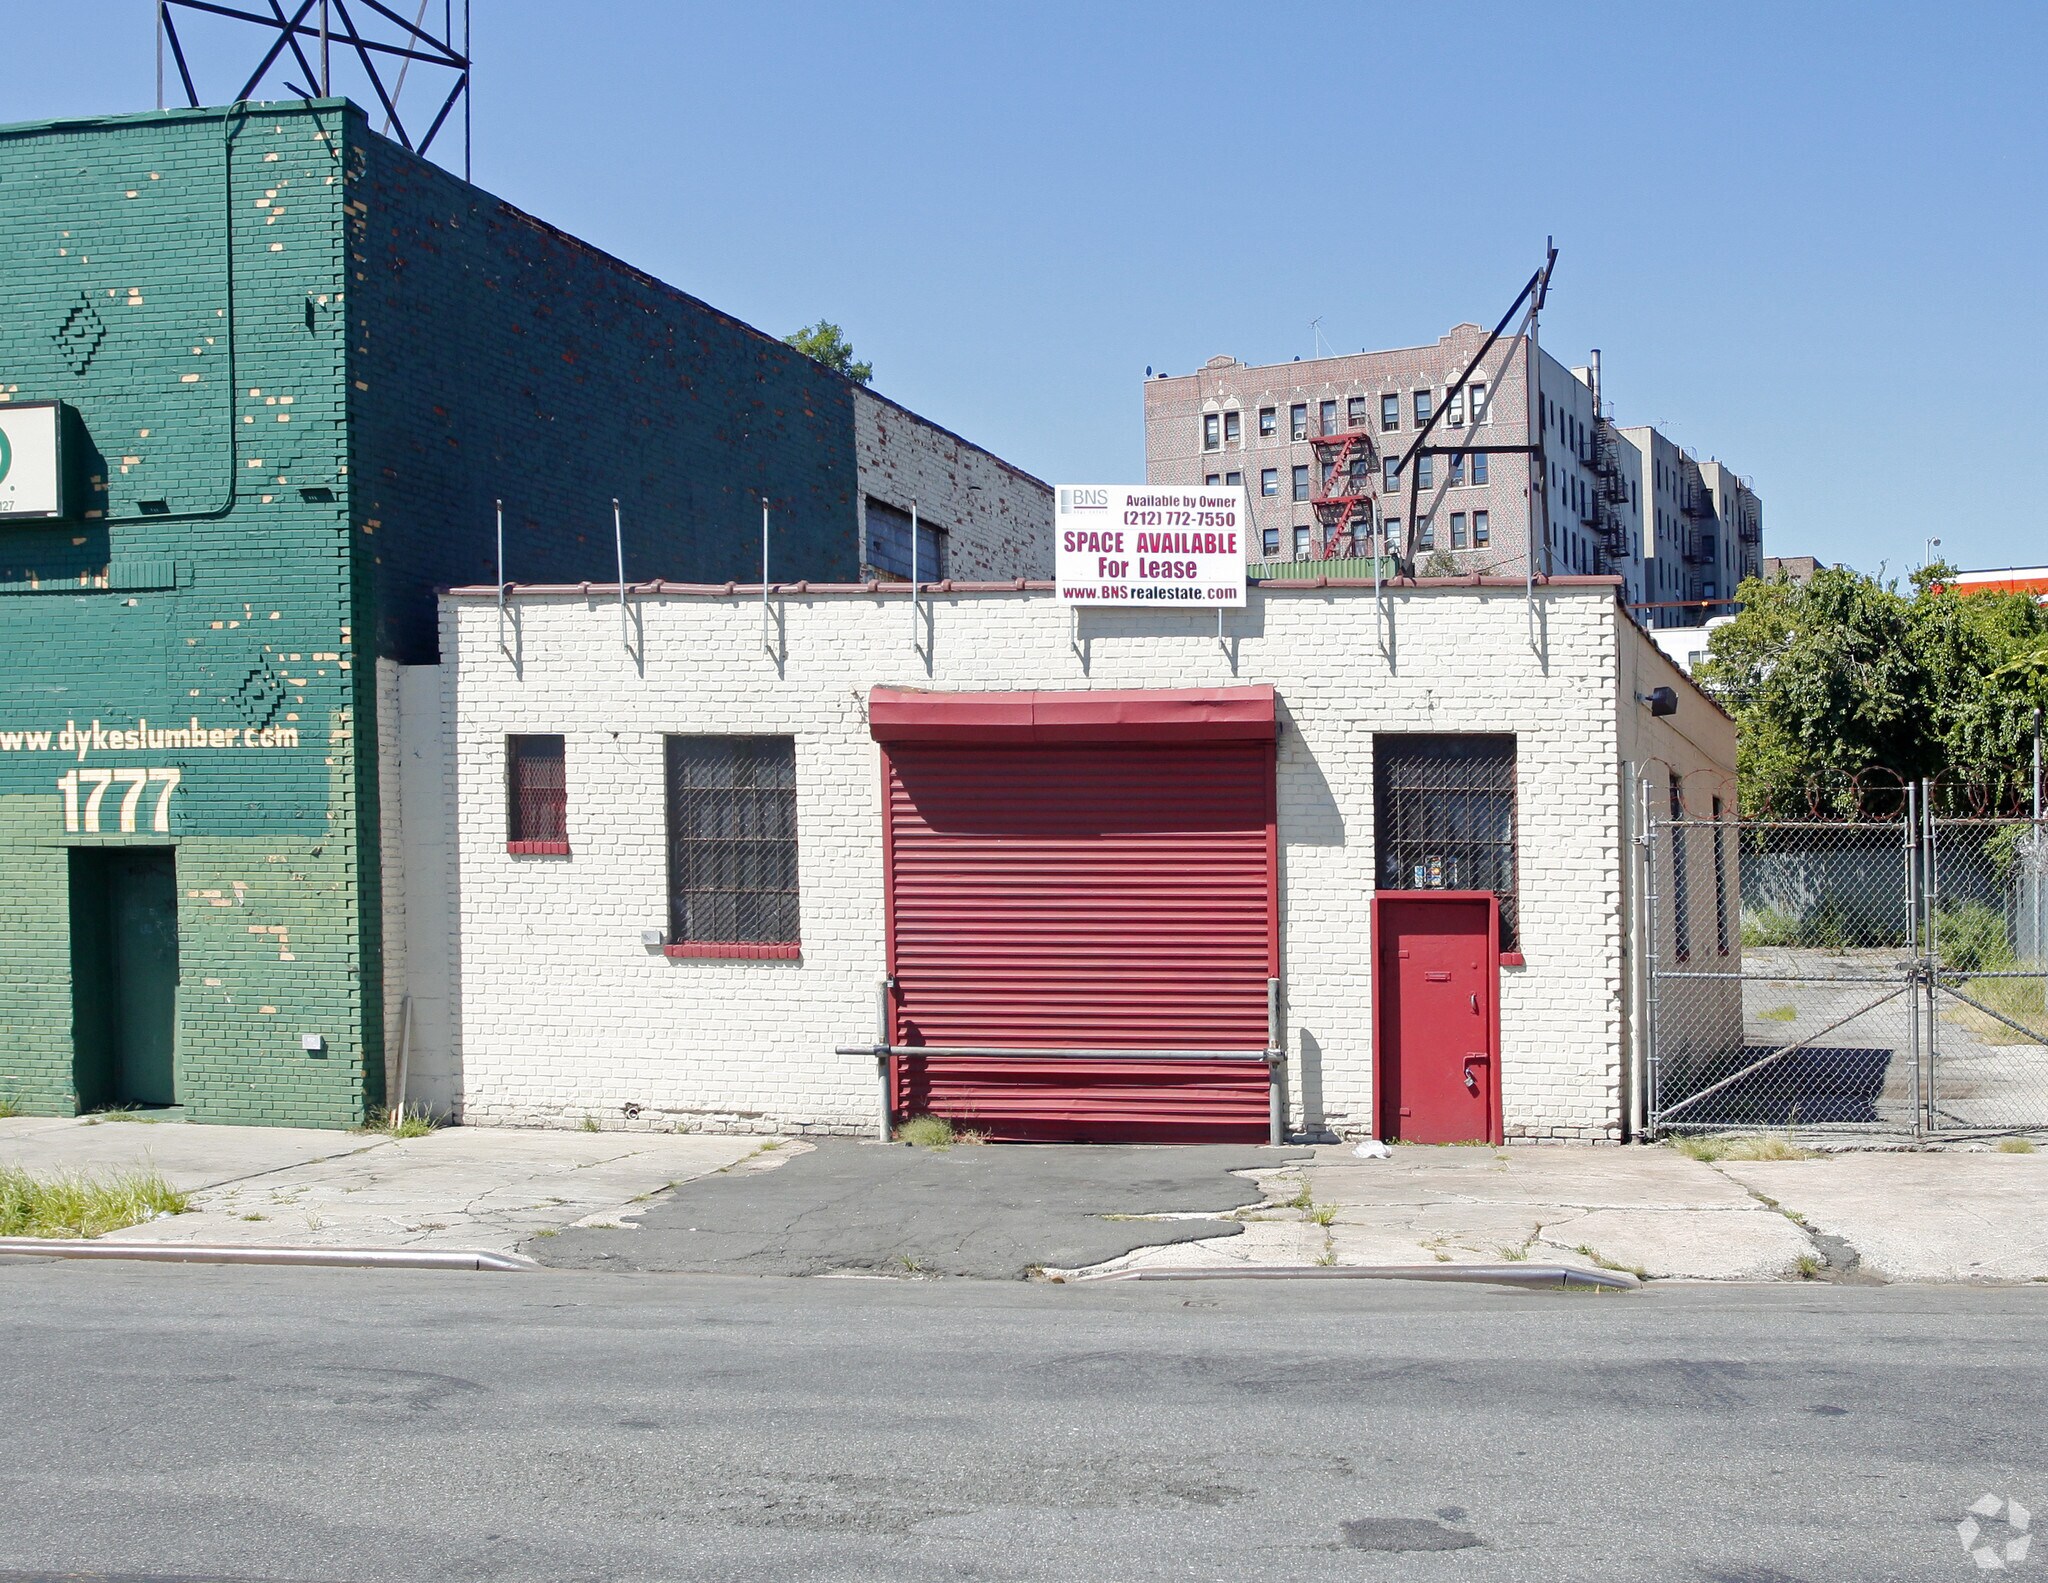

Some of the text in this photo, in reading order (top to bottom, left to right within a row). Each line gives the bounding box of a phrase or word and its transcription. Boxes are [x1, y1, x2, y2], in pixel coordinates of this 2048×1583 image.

[1073, 489, 1108, 505] BNS
[1126, 495, 1237, 508] Available by Owner
[1124, 511, 1236, 527] (212) 772-7550
[1063, 531, 1238, 554] SPACE AVAILABLE
[1098, 557, 1198, 579] For Lease
[57, 768, 181, 832] 1777
